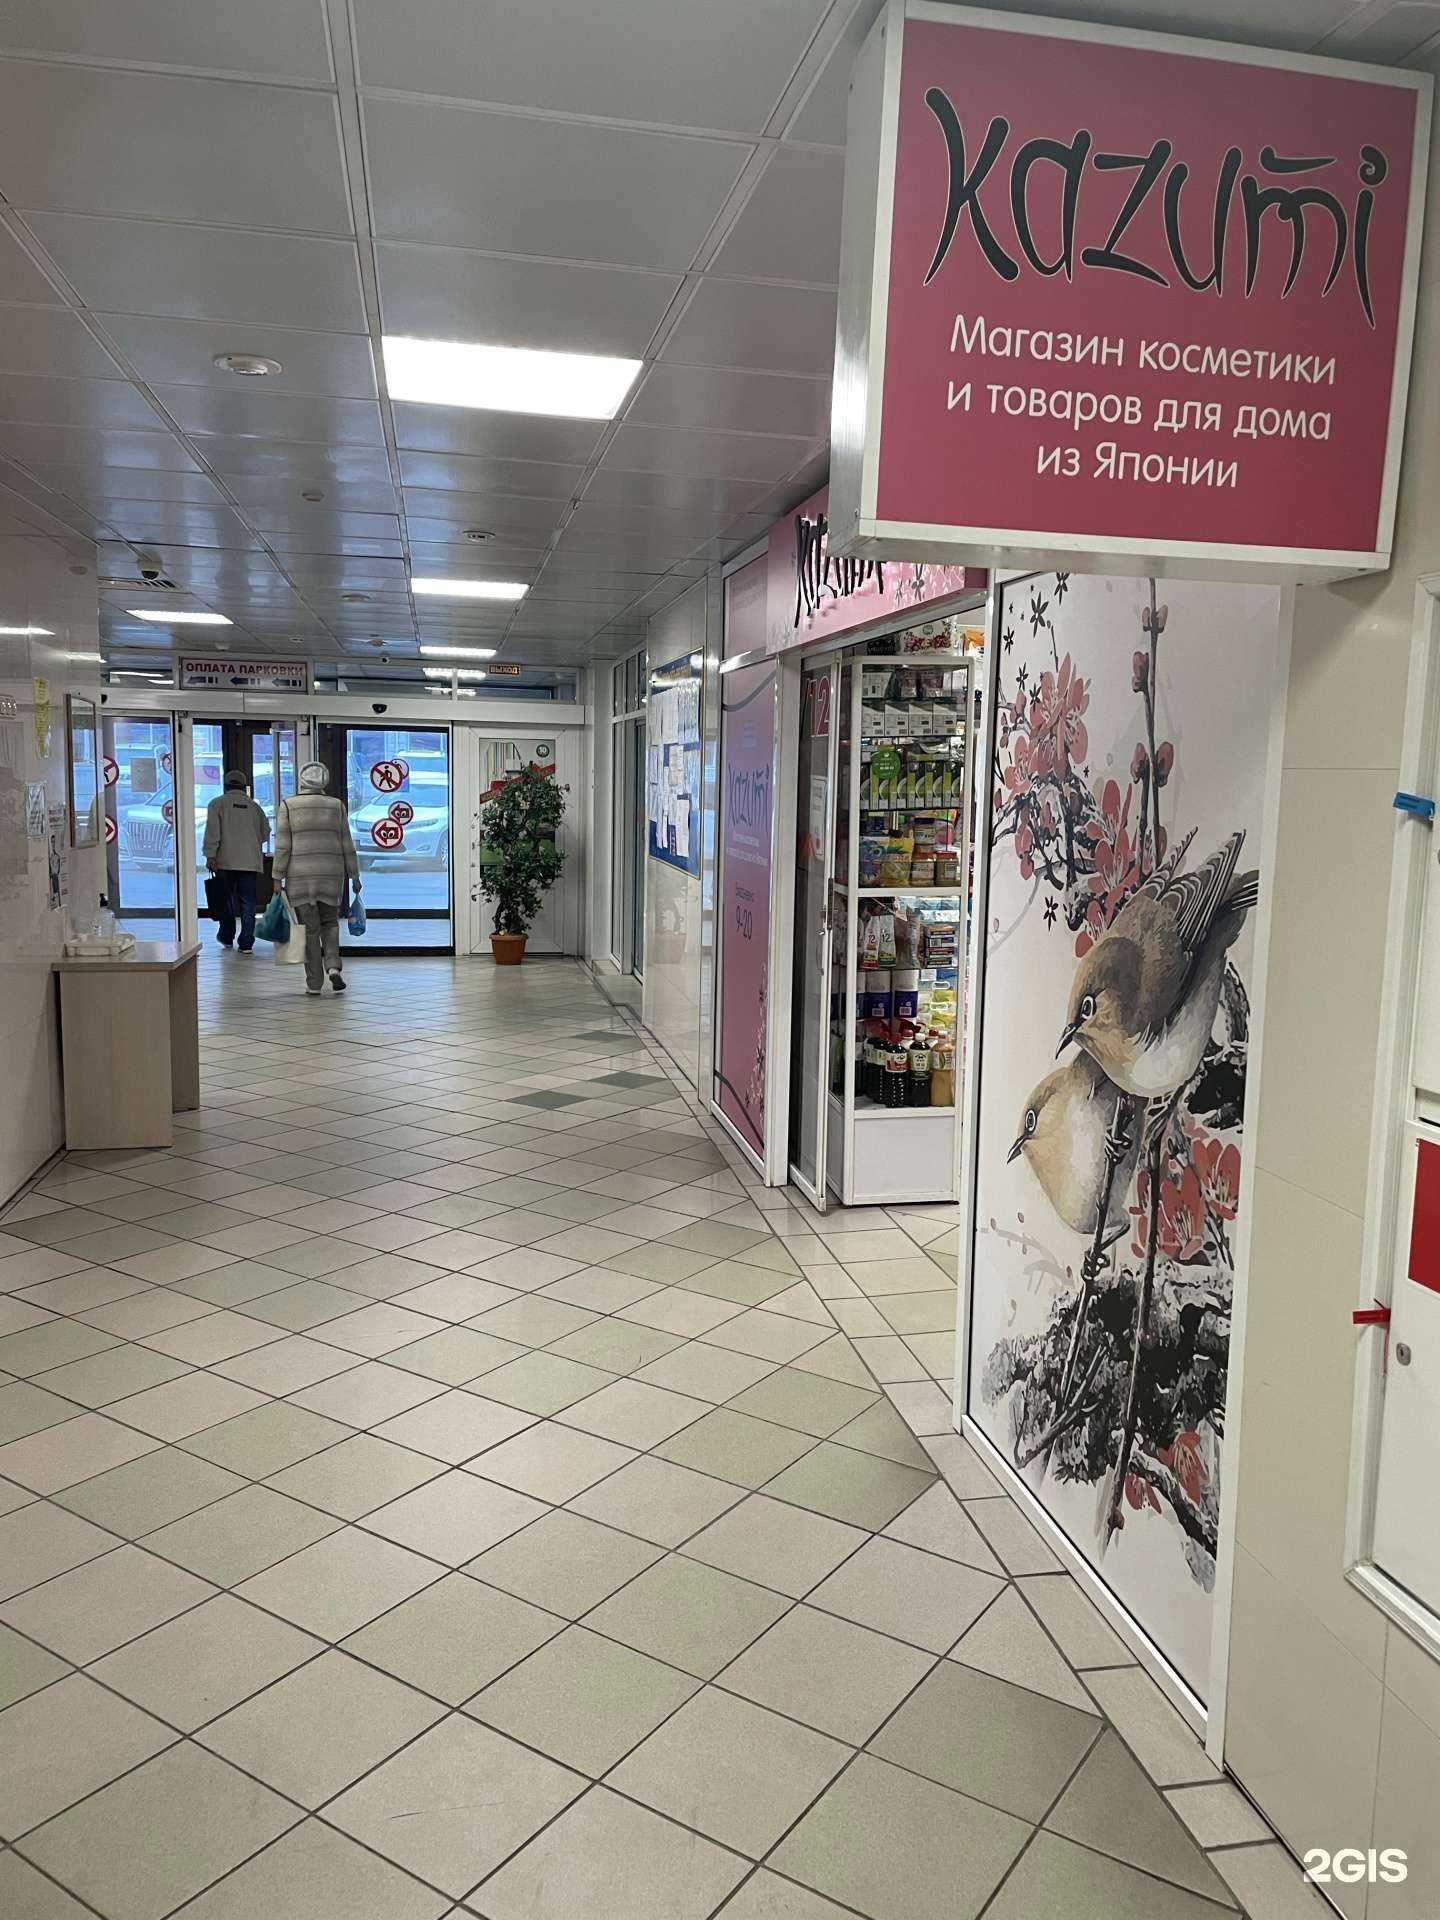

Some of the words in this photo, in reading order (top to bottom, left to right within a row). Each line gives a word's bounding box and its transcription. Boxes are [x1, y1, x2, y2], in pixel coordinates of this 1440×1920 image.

[950, 314, 1125, 366] Магазин
[1139, 338, 1336, 385] косметики
[946, 380, 972, 411] и
[986, 382, 1142, 429] товаров
[1153, 398, 1222, 433] для
[1232, 405, 1332, 440] дома
[1036, 444, 1081, 477] из
[1094, 441, 1239, 488] Японии
[186, 663, 235, 674] ОПЛАТА
[240, 664, 304, 676] ПАРКОВКИ
